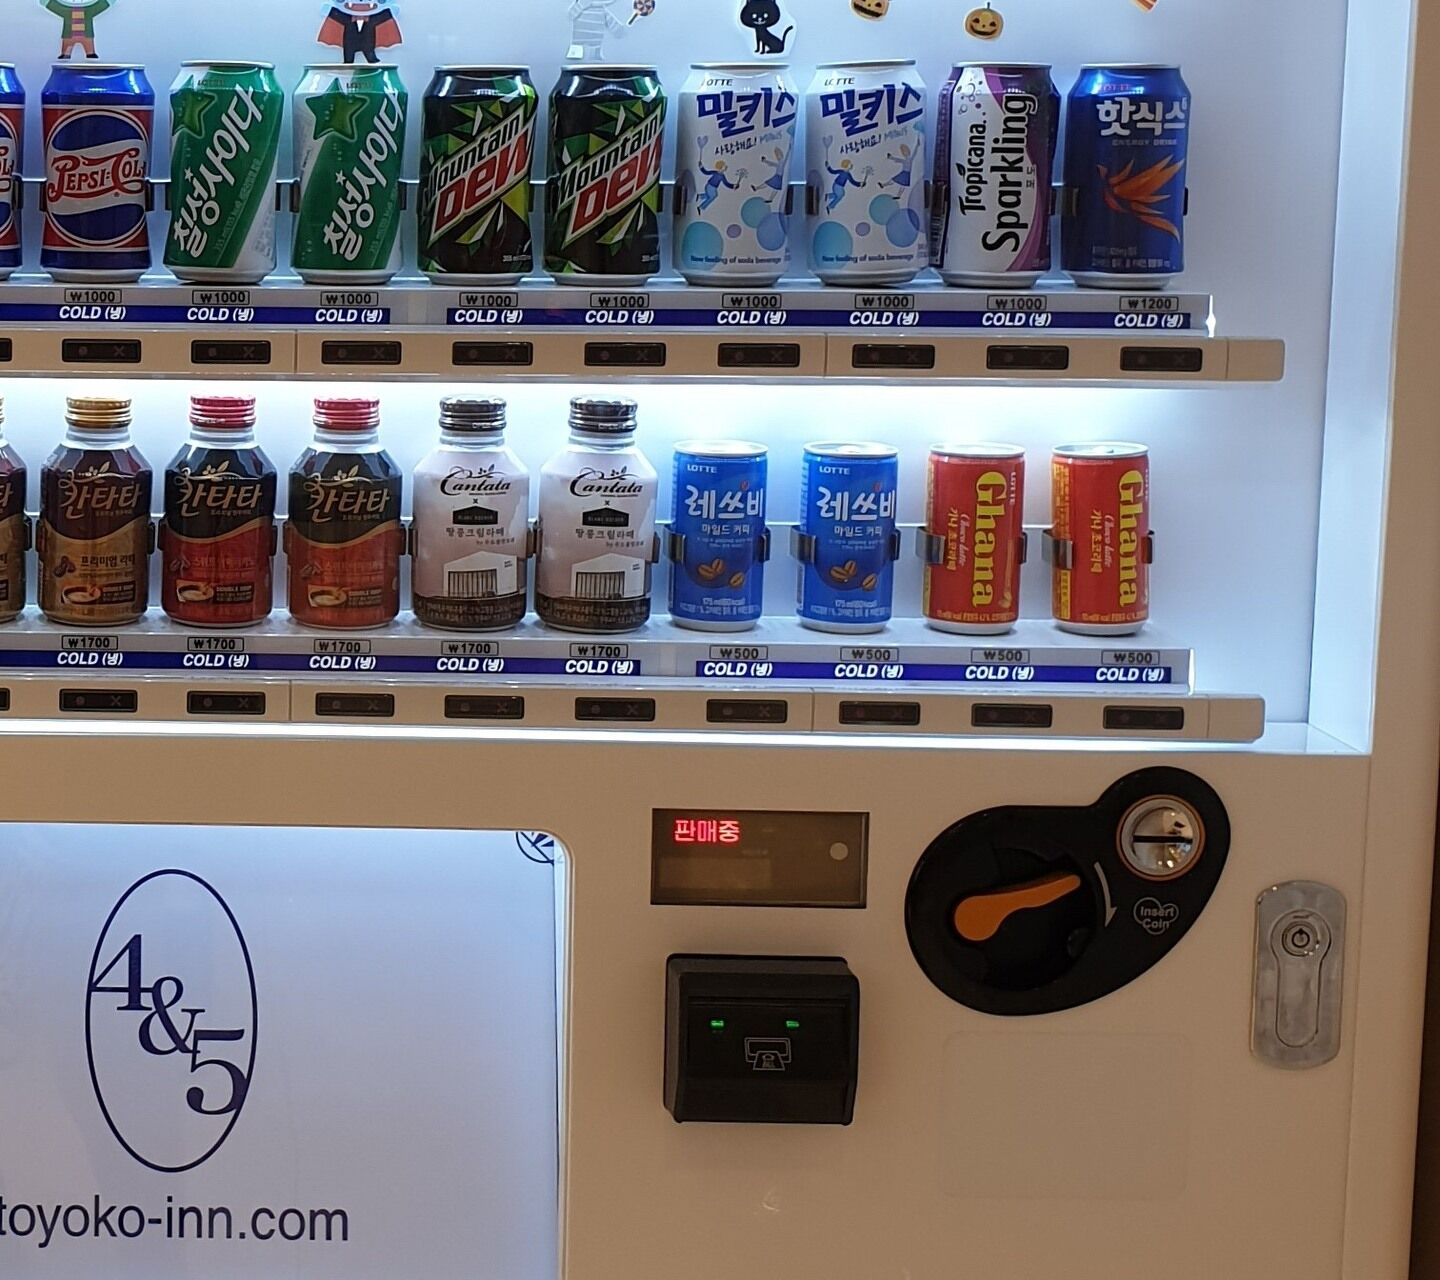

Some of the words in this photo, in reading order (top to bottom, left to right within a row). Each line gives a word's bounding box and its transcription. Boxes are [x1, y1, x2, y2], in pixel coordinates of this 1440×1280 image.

[696, 87, 796, 138] 밀키스
[820, 83, 924, 137] 밀키스
[955, 120, 987, 216] Tropicana
[981, 92, 1038, 252] Sparkling
[59, 305, 103, 319] COLD
[849, 311, 893, 325] COLD
[1114, 314, 1158, 327] COLD
[687, 464, 718, 474] LOTTE
[819, 465, 850, 475] LOTTE
[58, 470, 143, 519] 칸타타
[440, 470, 511, 496] Cantata
[570, 471, 643, 498] Cantata
[685, 485, 764, 520] 레쓰비
[817, 486, 896, 521] 레쓰비
[702, 524, 730, 536] 마일드
[732, 524, 750, 535] 커피
[972, 471, 1007, 608] Ghana
[1118, 470, 1144, 607] Ghana
[565, 660, 608, 673] COLD
[965, 666, 1009, 680] COLD
[674, 819, 740, 843] 판매중
[1139, 906, 1175, 918] Insert
[1143, 917, 1170, 929] Coin
